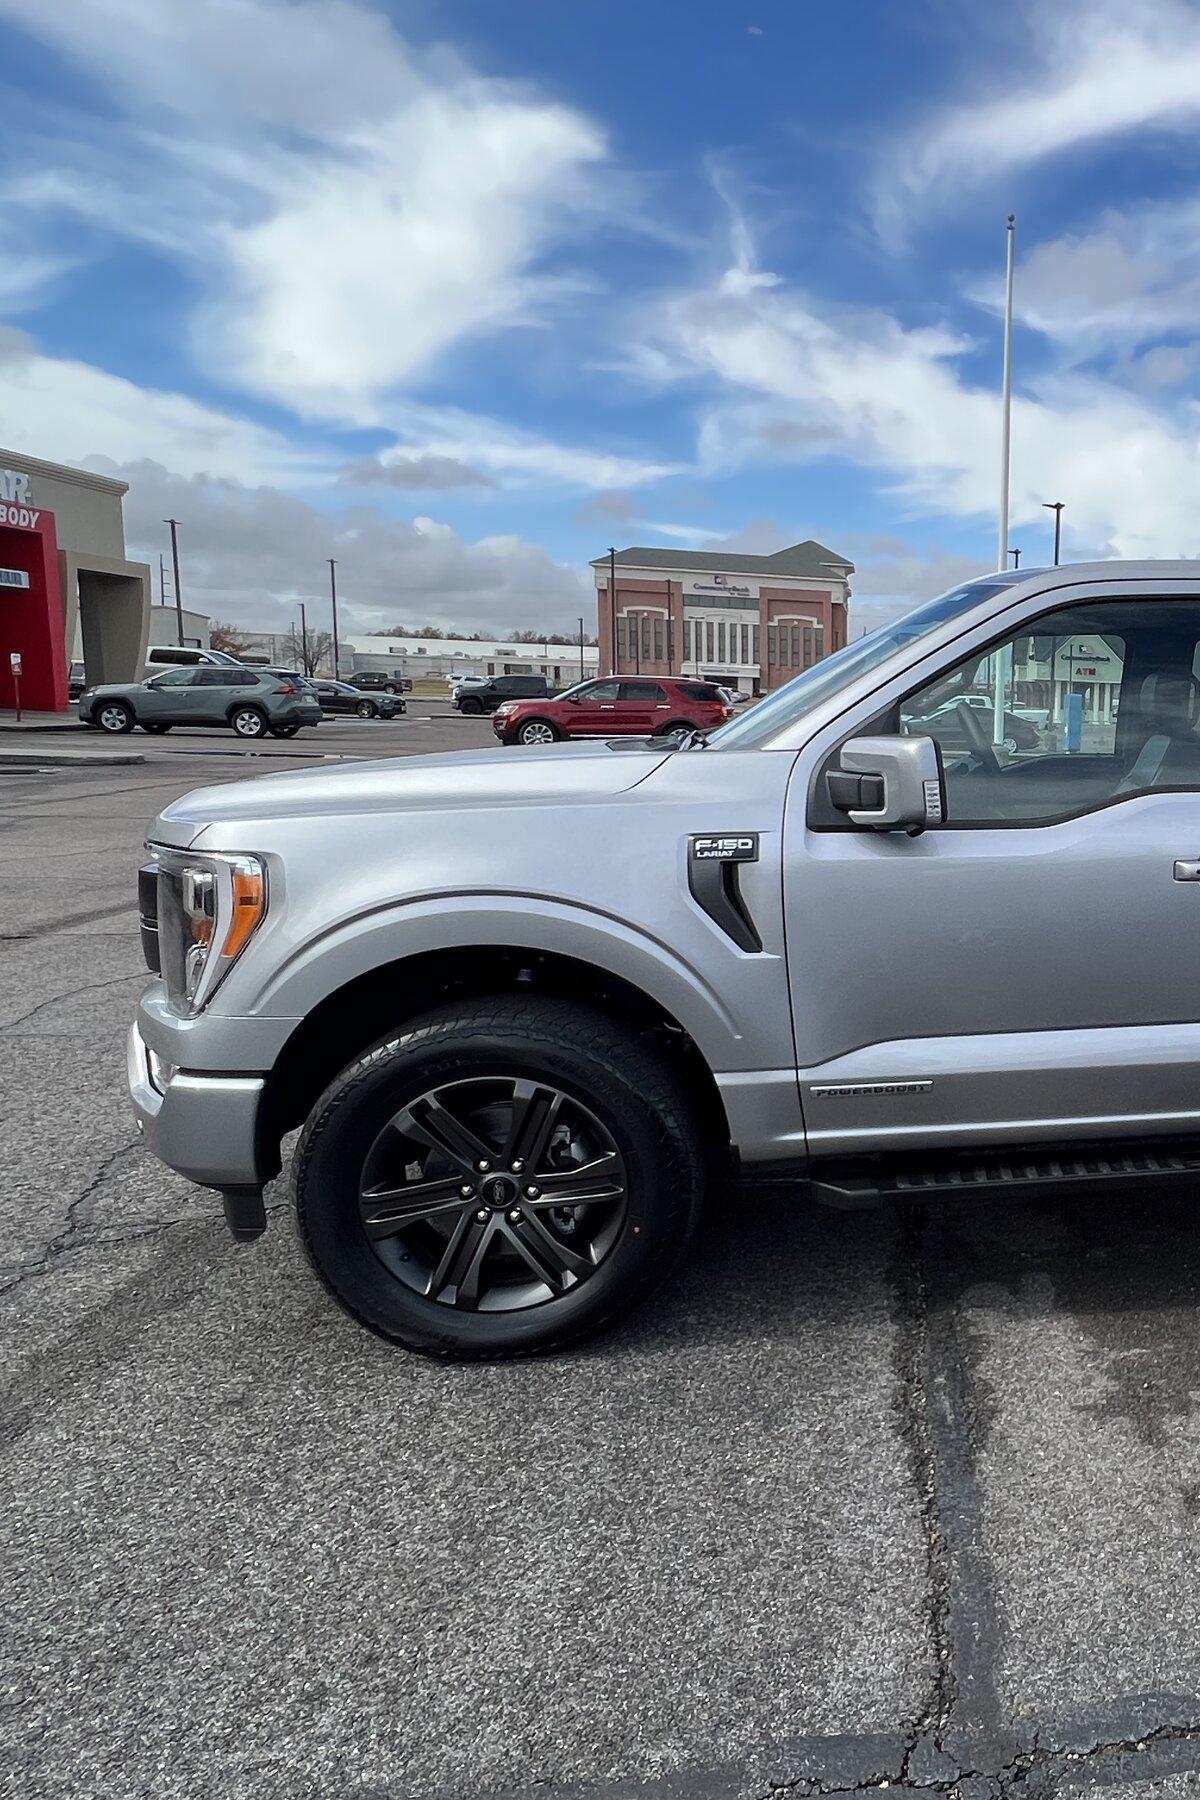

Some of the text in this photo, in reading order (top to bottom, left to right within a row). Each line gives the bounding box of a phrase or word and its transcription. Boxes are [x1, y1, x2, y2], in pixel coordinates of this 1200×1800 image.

[0, 504, 40, 529] BODY
[1075, 667, 1096, 675] ATM
[695, 838, 753, 850] F-150
[816, 1084, 925, 1097] POWERBOOST
